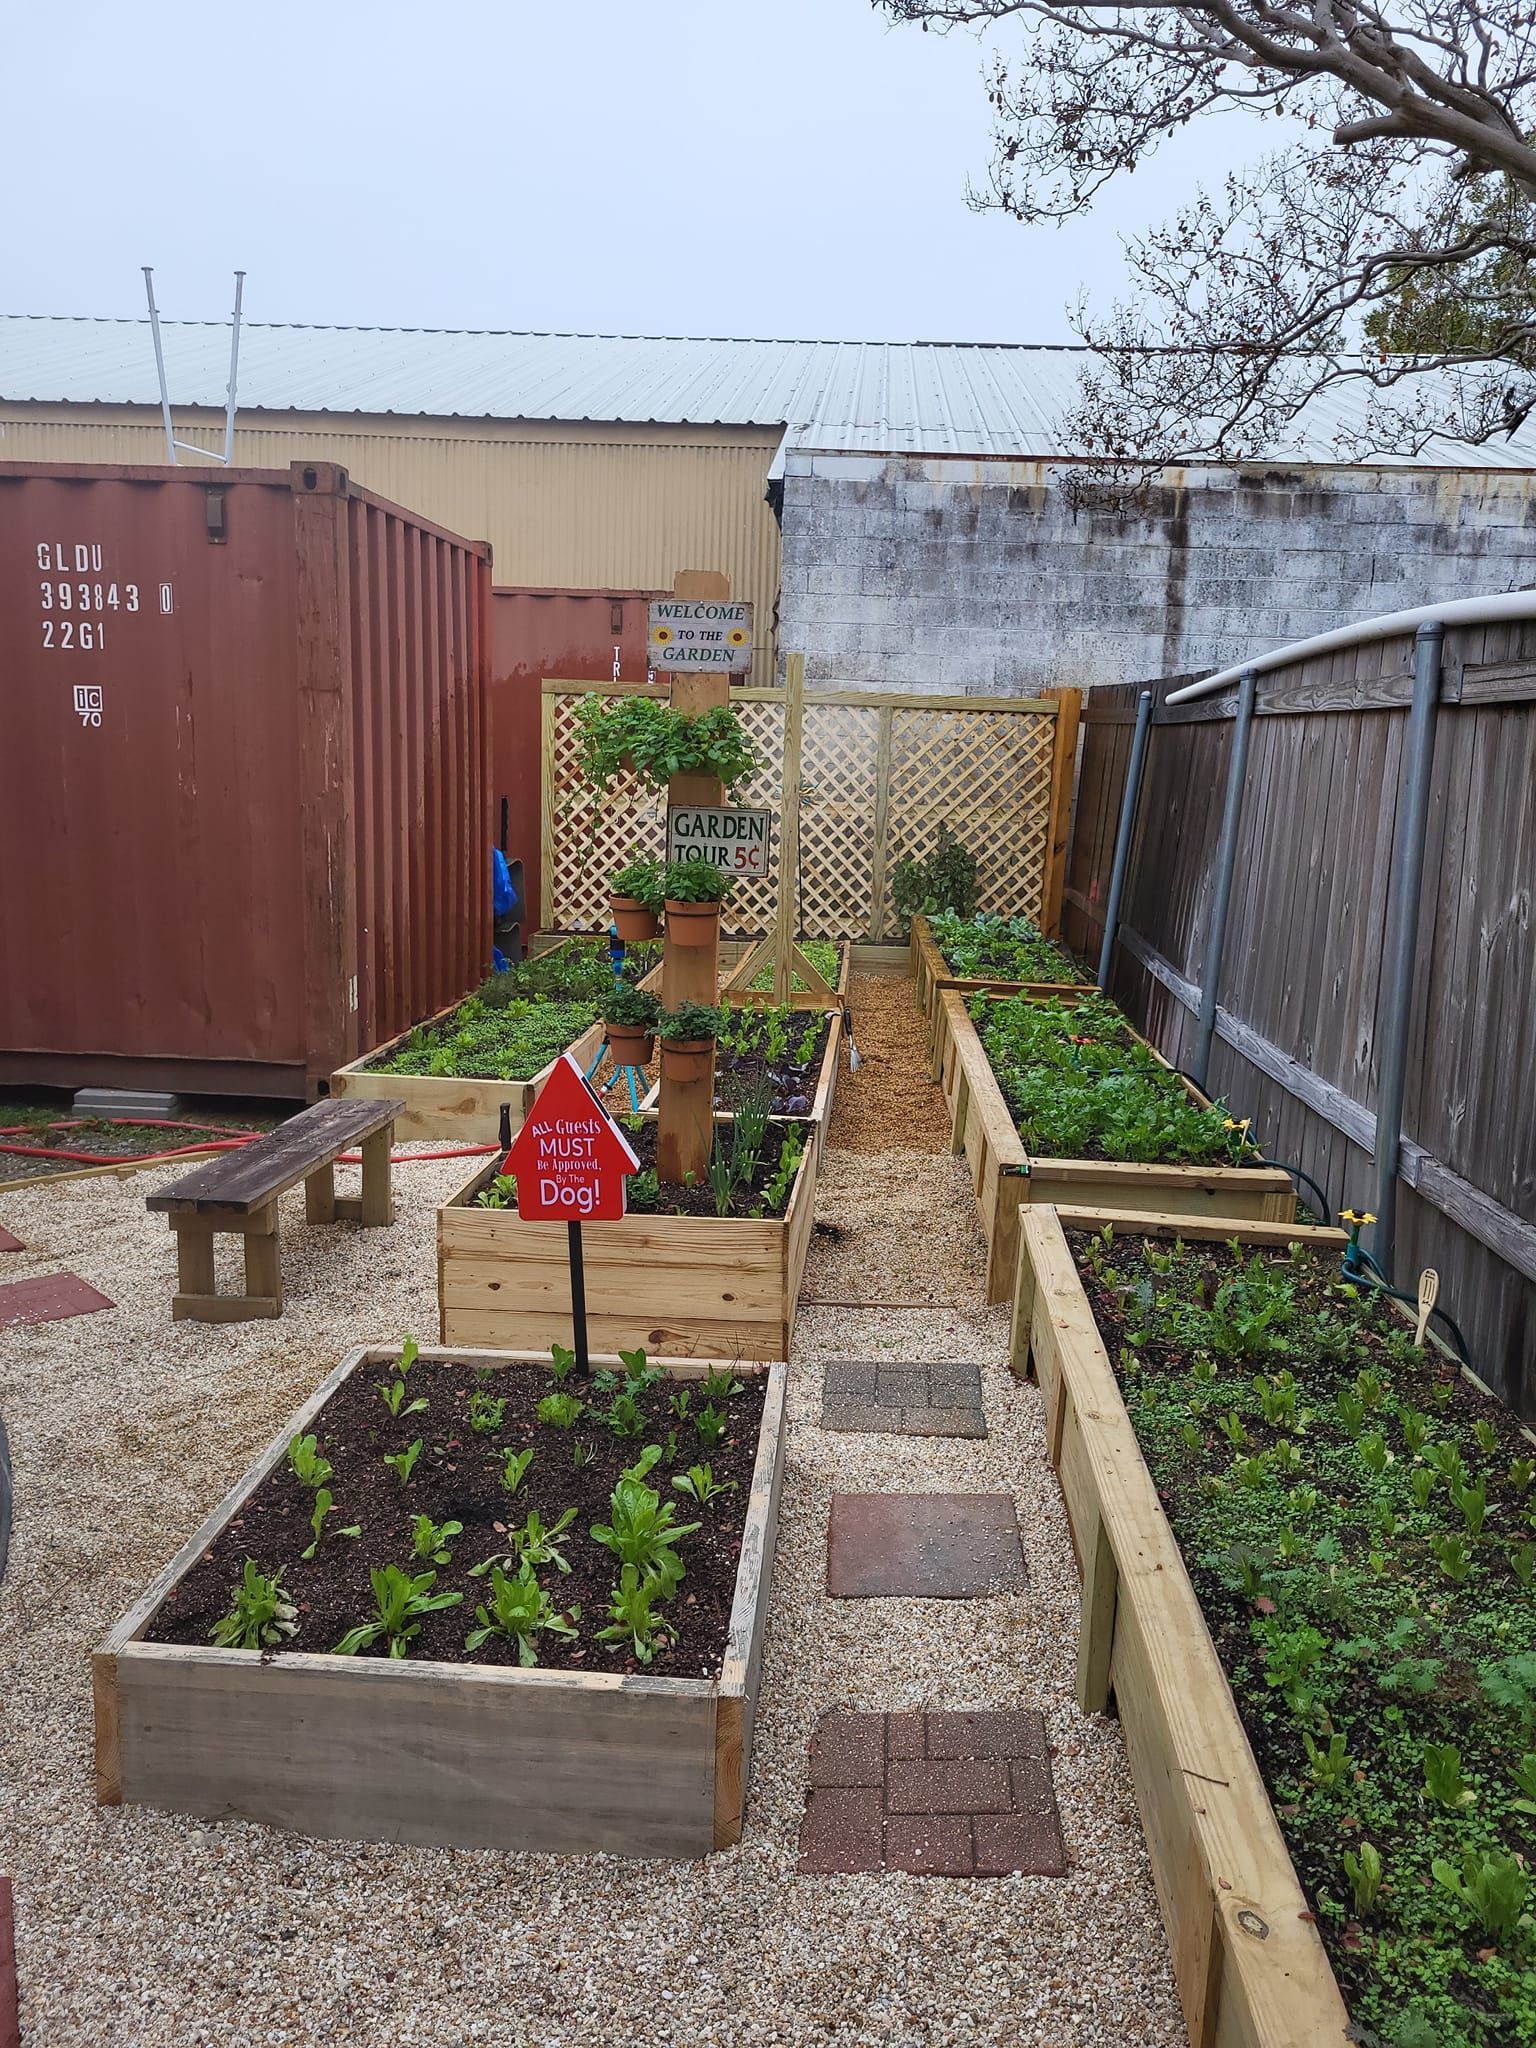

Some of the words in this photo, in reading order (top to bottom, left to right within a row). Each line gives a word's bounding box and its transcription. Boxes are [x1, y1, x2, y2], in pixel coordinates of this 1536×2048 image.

[37, 543, 102, 572] GLDU
[41, 582, 139, 612] 393843
[657, 604, 744, 620] WELCOME
[42, 621, 105, 650] 22G1
[678, 630, 694, 640] TO
[699, 630, 723, 641] THE
[663, 647, 735, 662] GARDEN
[79, 712, 101, 727] 70
[675, 814, 764, 841] GARDEN
[675, 845, 730, 866] TOUR
[734, 845, 759, 869] 5¢
[532, 1121, 552, 1137] ALL
[556, 1119, 601, 1135] Guests
[540, 1138, 595, 1157] MUST
[537, 1159, 549, 1170] Be
[552, 1159, 601, 1172] Approved,
[556, 1175, 566, 1185] By
[569, 1174, 584, 1183] The
[540, 1179, 600, 1213] Dog!
